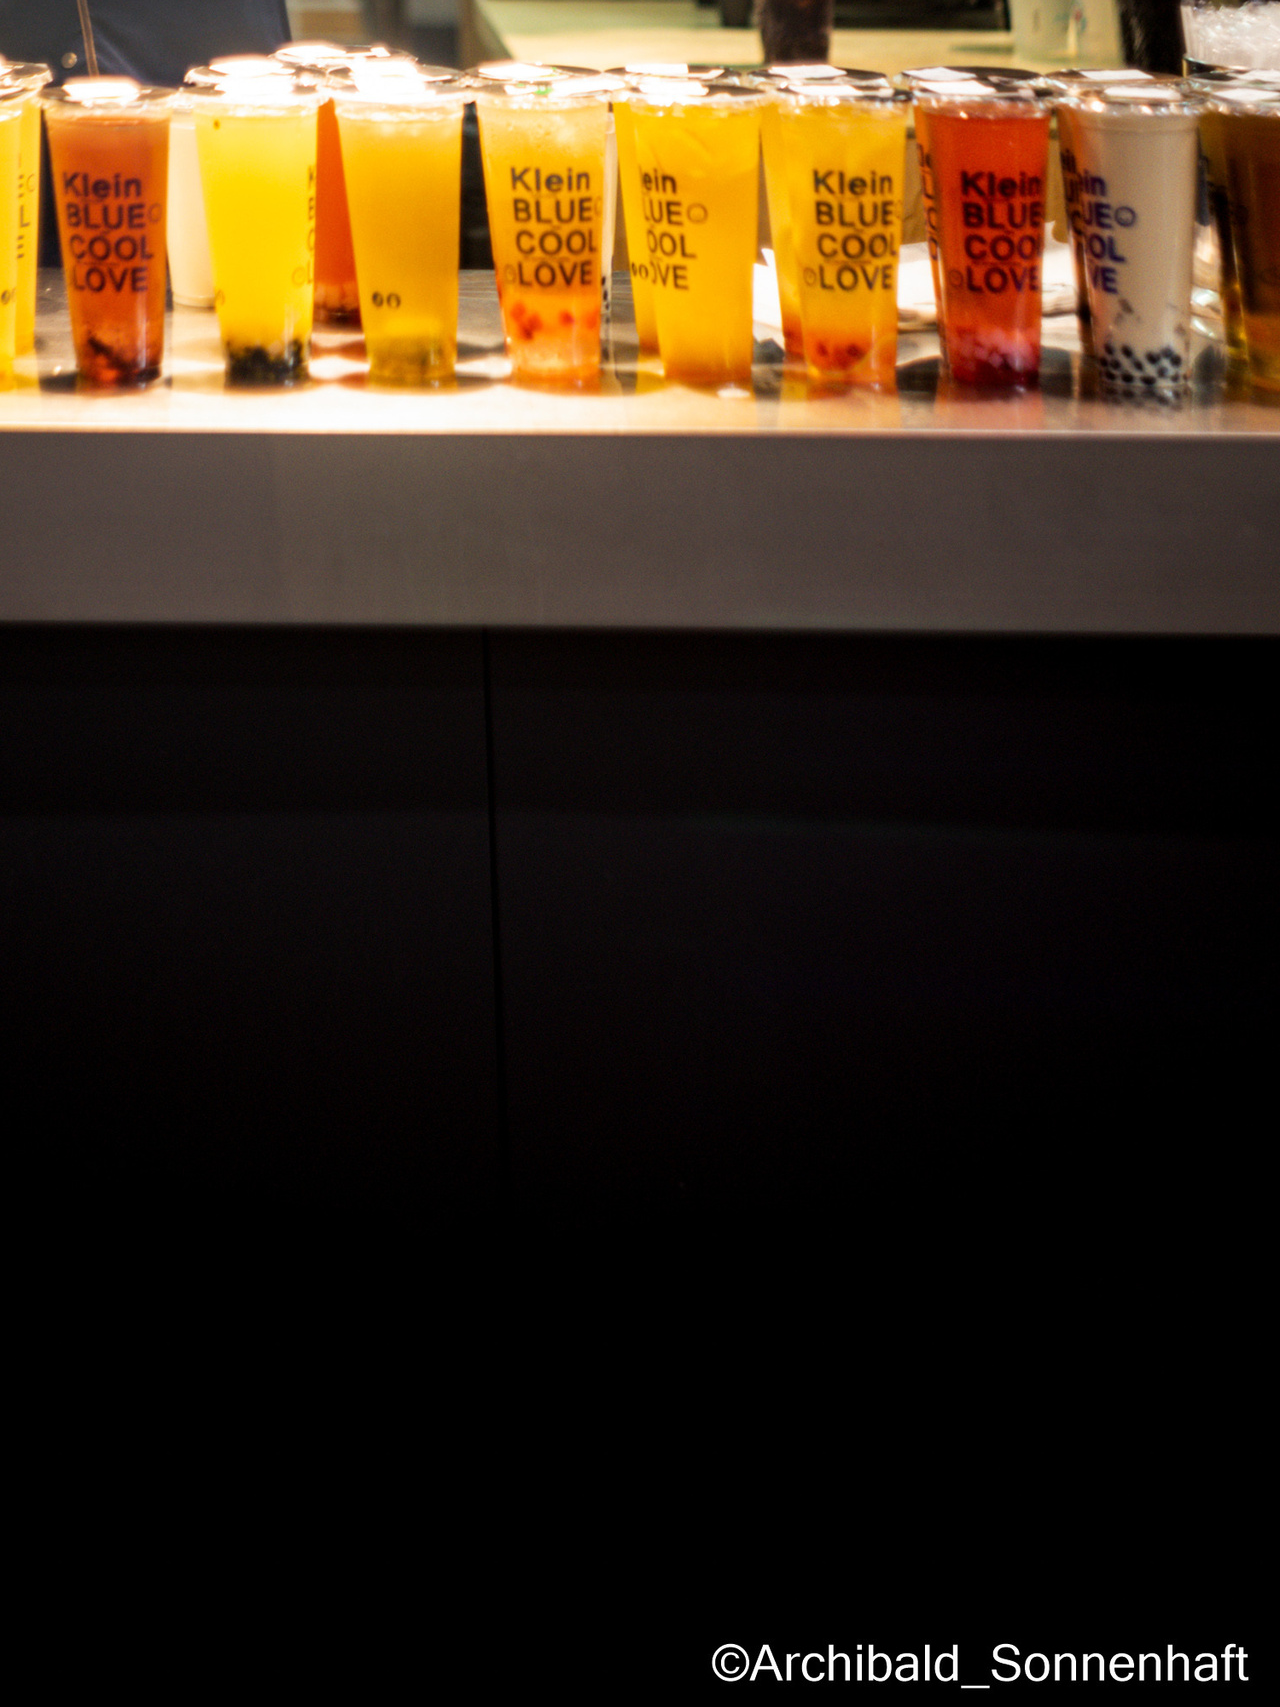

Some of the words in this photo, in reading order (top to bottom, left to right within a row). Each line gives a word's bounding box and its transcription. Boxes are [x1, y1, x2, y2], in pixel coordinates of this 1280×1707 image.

[63, 172, 142, 199] Klein
[510, 167, 591, 193] Klein
[813, 169, 893, 196] Klein
[960, 170, 1042, 197] Klein
[66, 202, 146, 230] BLUE
[513, 197, 593, 224] BLUE
[815, 200, 894, 227] BLUE
[962, 201, 1043, 229] BLUE
[70, 234, 154, 262] COOL
[516, 229, 598, 256] COOL
[818, 233, 897, 260] COOL
[73, 266, 149, 293] LOVE
[517, 260, 593, 288] LOVE
[820, 264, 893, 291] LOVE
